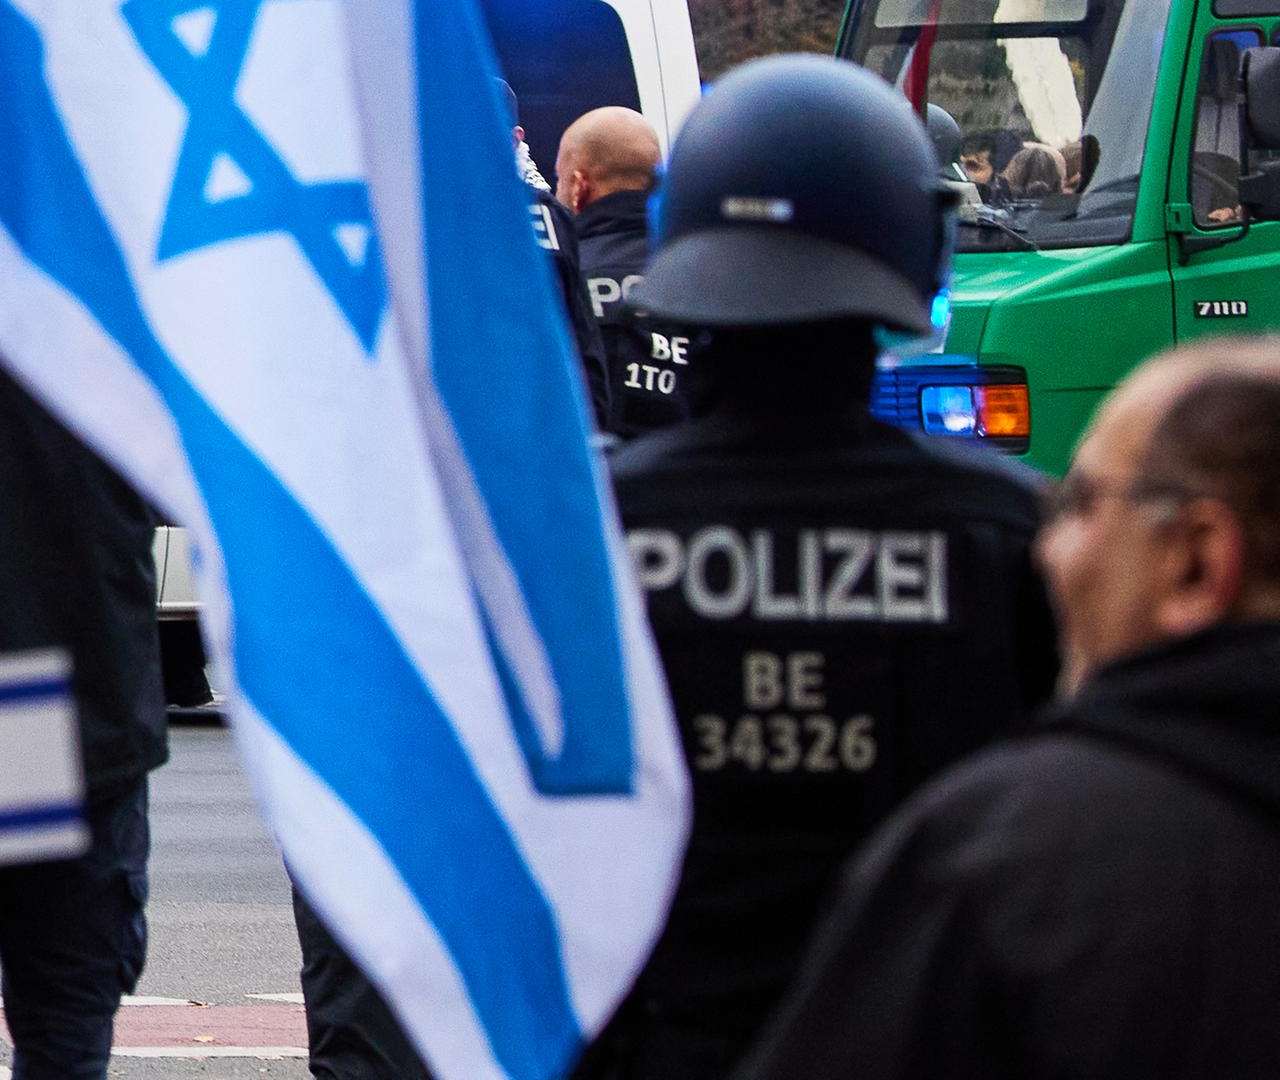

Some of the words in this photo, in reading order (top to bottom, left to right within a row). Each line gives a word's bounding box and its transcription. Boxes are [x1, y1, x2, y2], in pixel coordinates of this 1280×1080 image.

[650, 332, 690, 365] BE
[626, 527, 947, 622] POLIZEI
[742, 651, 826, 711] BE
[694, 716, 876, 774] 34326
